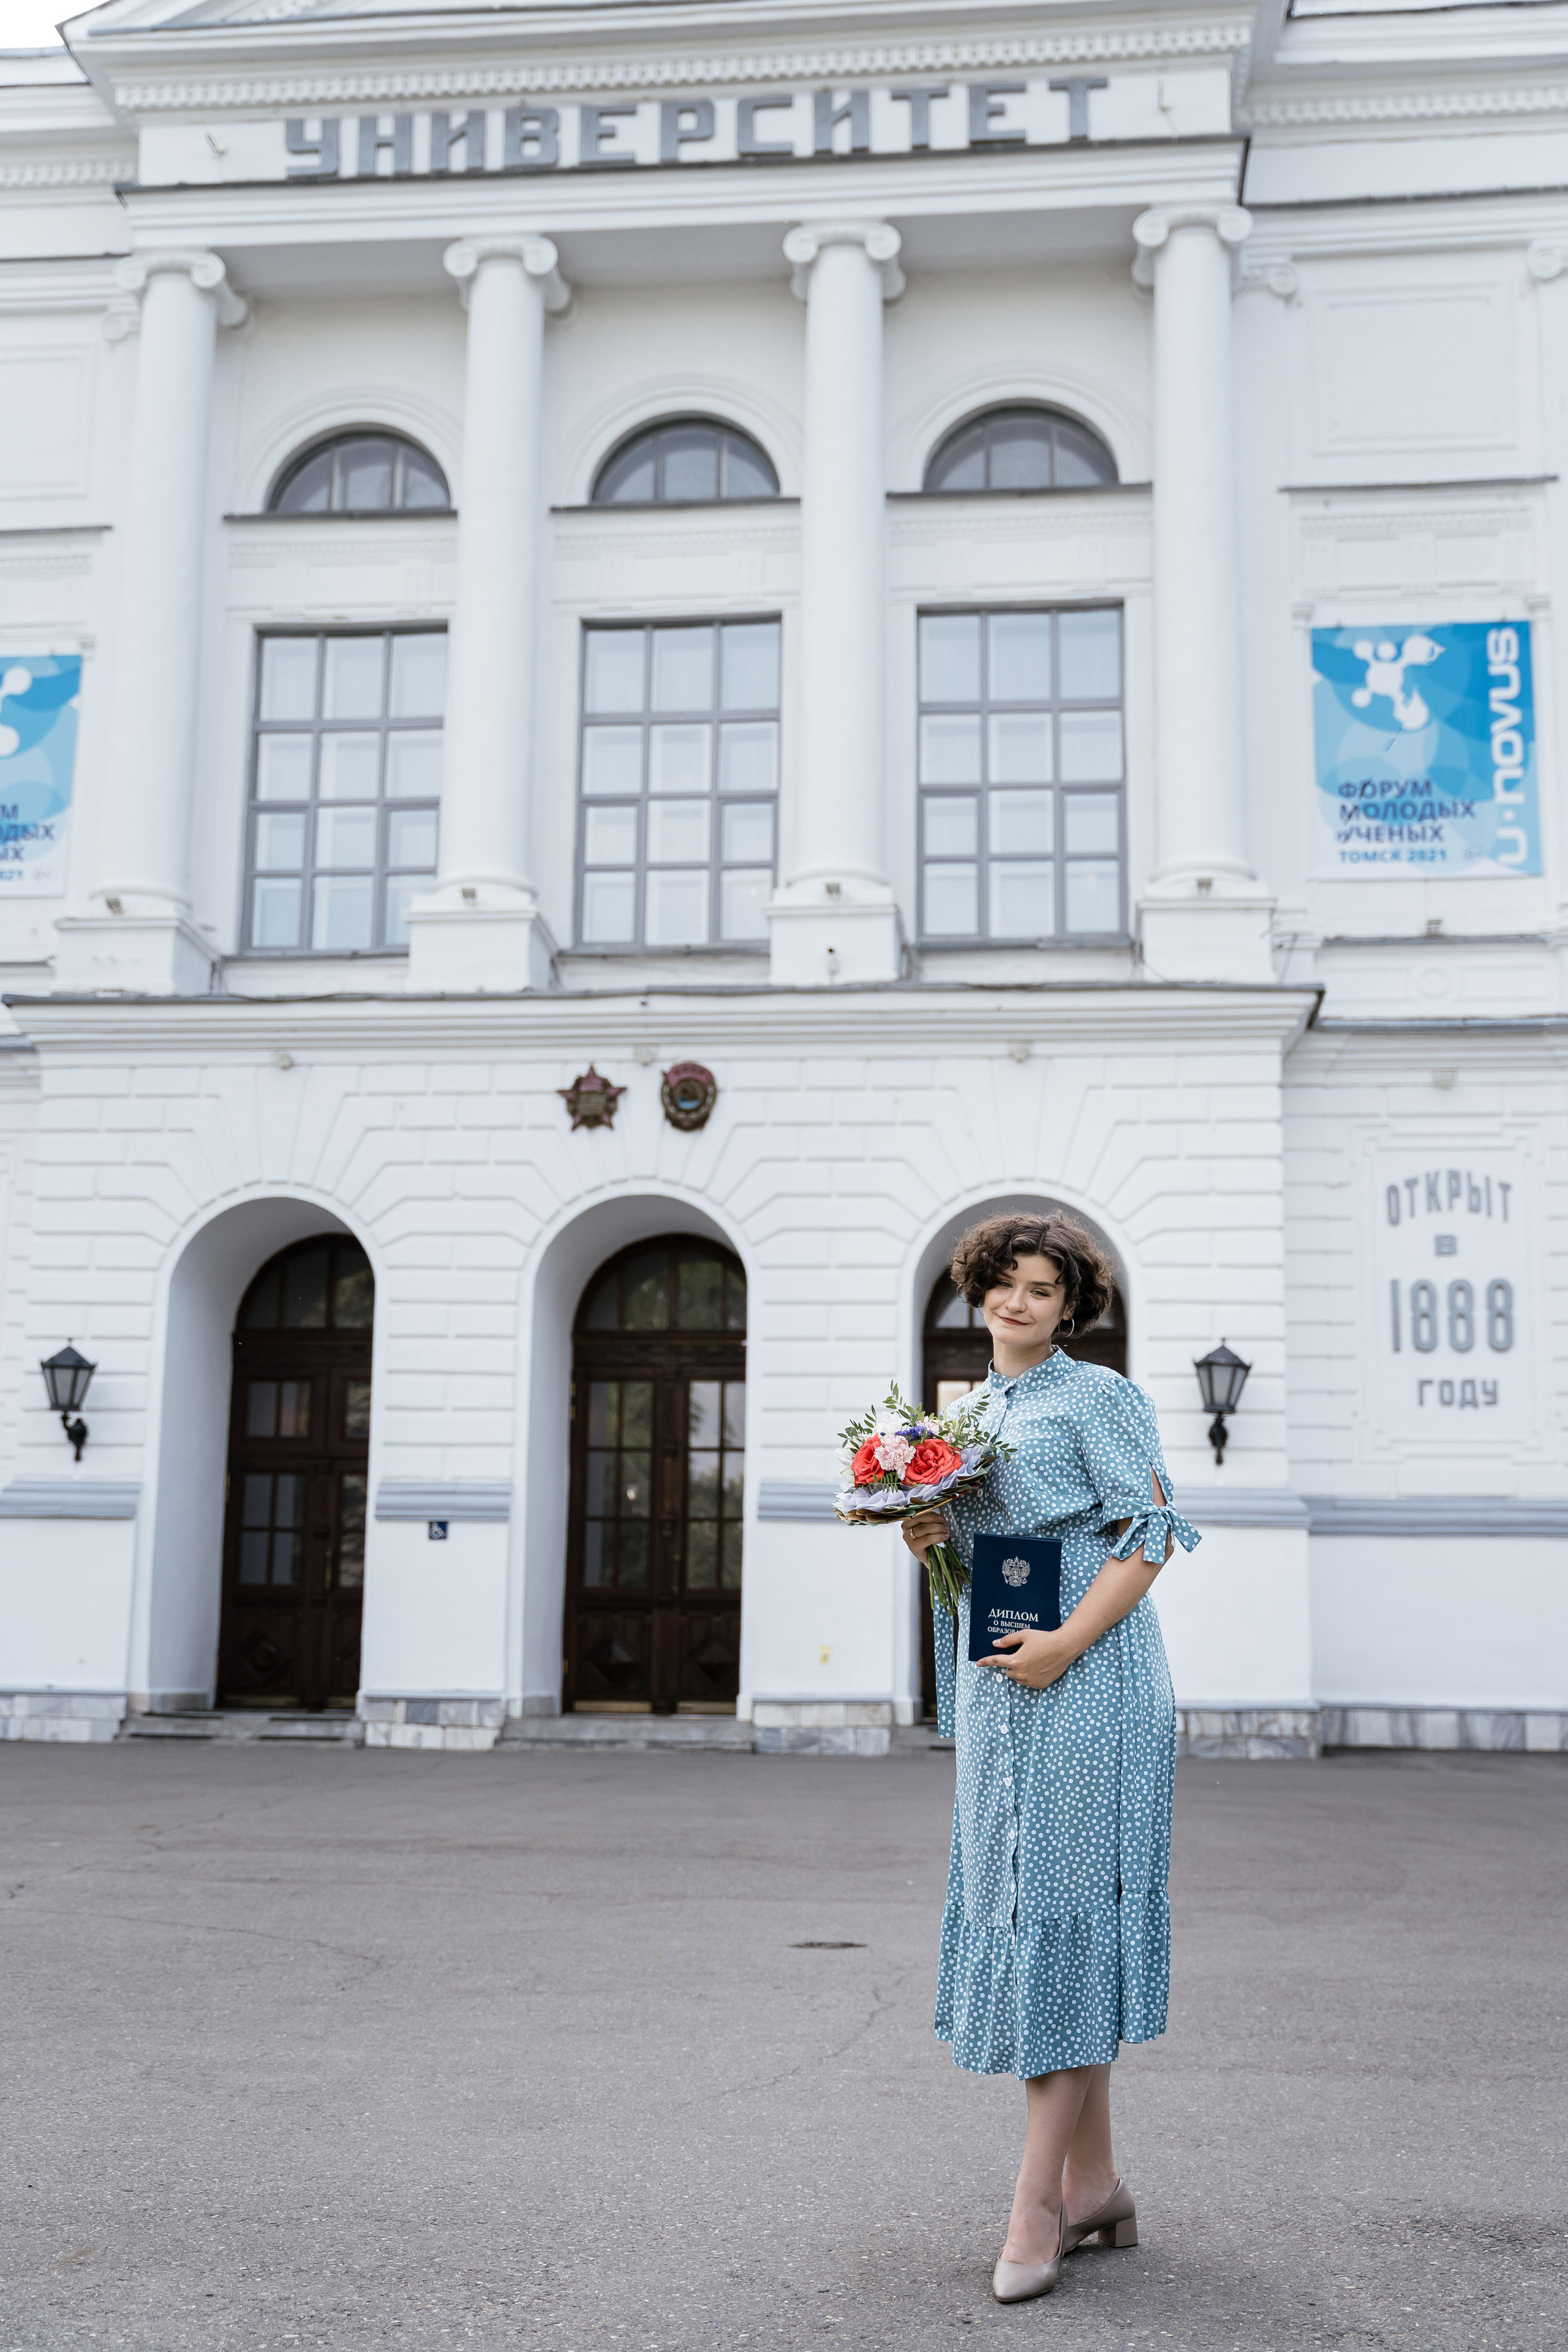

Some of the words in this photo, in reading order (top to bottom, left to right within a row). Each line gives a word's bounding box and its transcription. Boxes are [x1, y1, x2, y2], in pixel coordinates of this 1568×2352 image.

[285, 77, 1108, 180] УНИВЕРСИТЕТ
[1338, 780, 1432, 798] ФОРУМ
[1340, 801, 1475, 823] МОЛОДЫХ
[1338, 826, 1444, 843] УЧЕНЫХ
[1340, 850, 1401, 863] ТОМСК
[1387, 1170, 1512, 1226] ОТКРЫТ
[1435, 1234, 1457, 1255] В
[1390, 1278, 1513, 1353] 1888
[1418, 1379, 1498, 1408] ГОДУ
[988, 1608, 1039, 1623] ДИПЛОМ
[1000, 1621, 1030, 1629] ВЫСШЕМ
